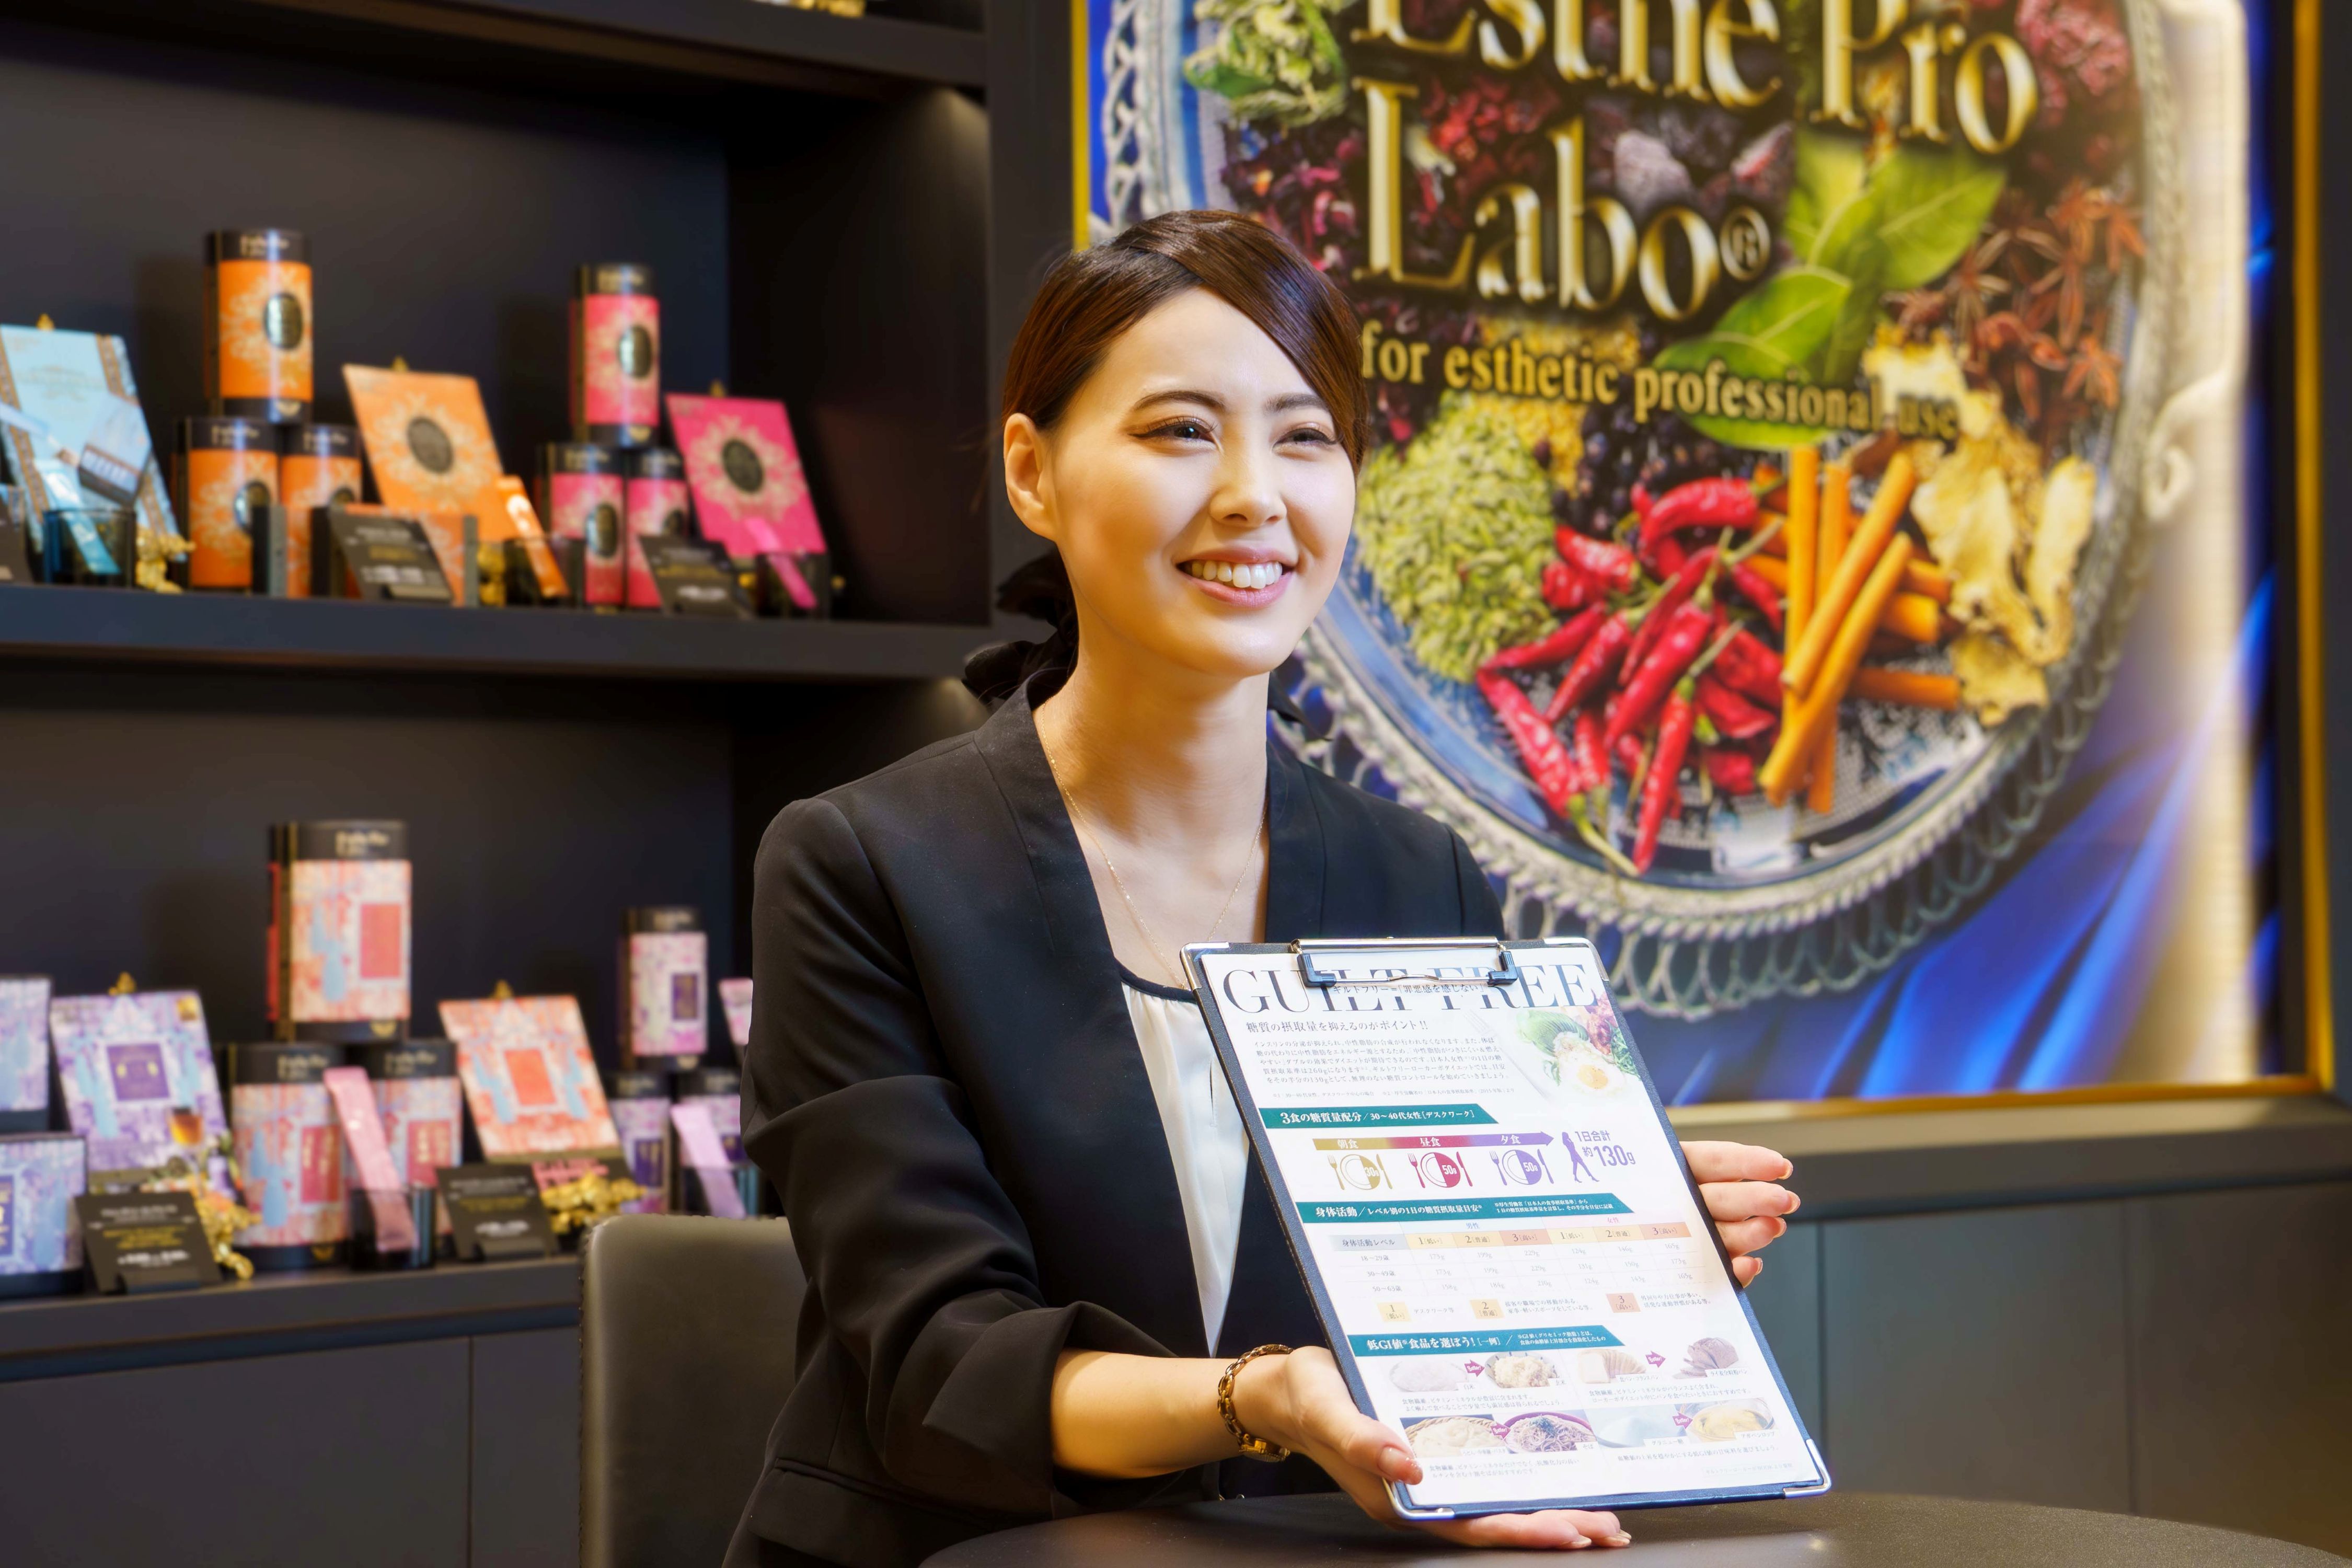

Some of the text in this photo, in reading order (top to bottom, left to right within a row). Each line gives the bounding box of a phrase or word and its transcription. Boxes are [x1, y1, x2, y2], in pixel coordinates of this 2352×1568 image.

[1806, 0, 2037, 156] Pro
[1360, 320, 1960, 440] for esthetic professional use
[1337, 1135, 1521, 1149] 朝食 昼食 夕食
[1575, 1129, 1611, 1142] 1日合計
[1442, 1165, 1457, 1175] 50g
[1523, 1162, 1538, 1172] 50g
[1342, 1238, 1395, 1247] 身体活動レベル
